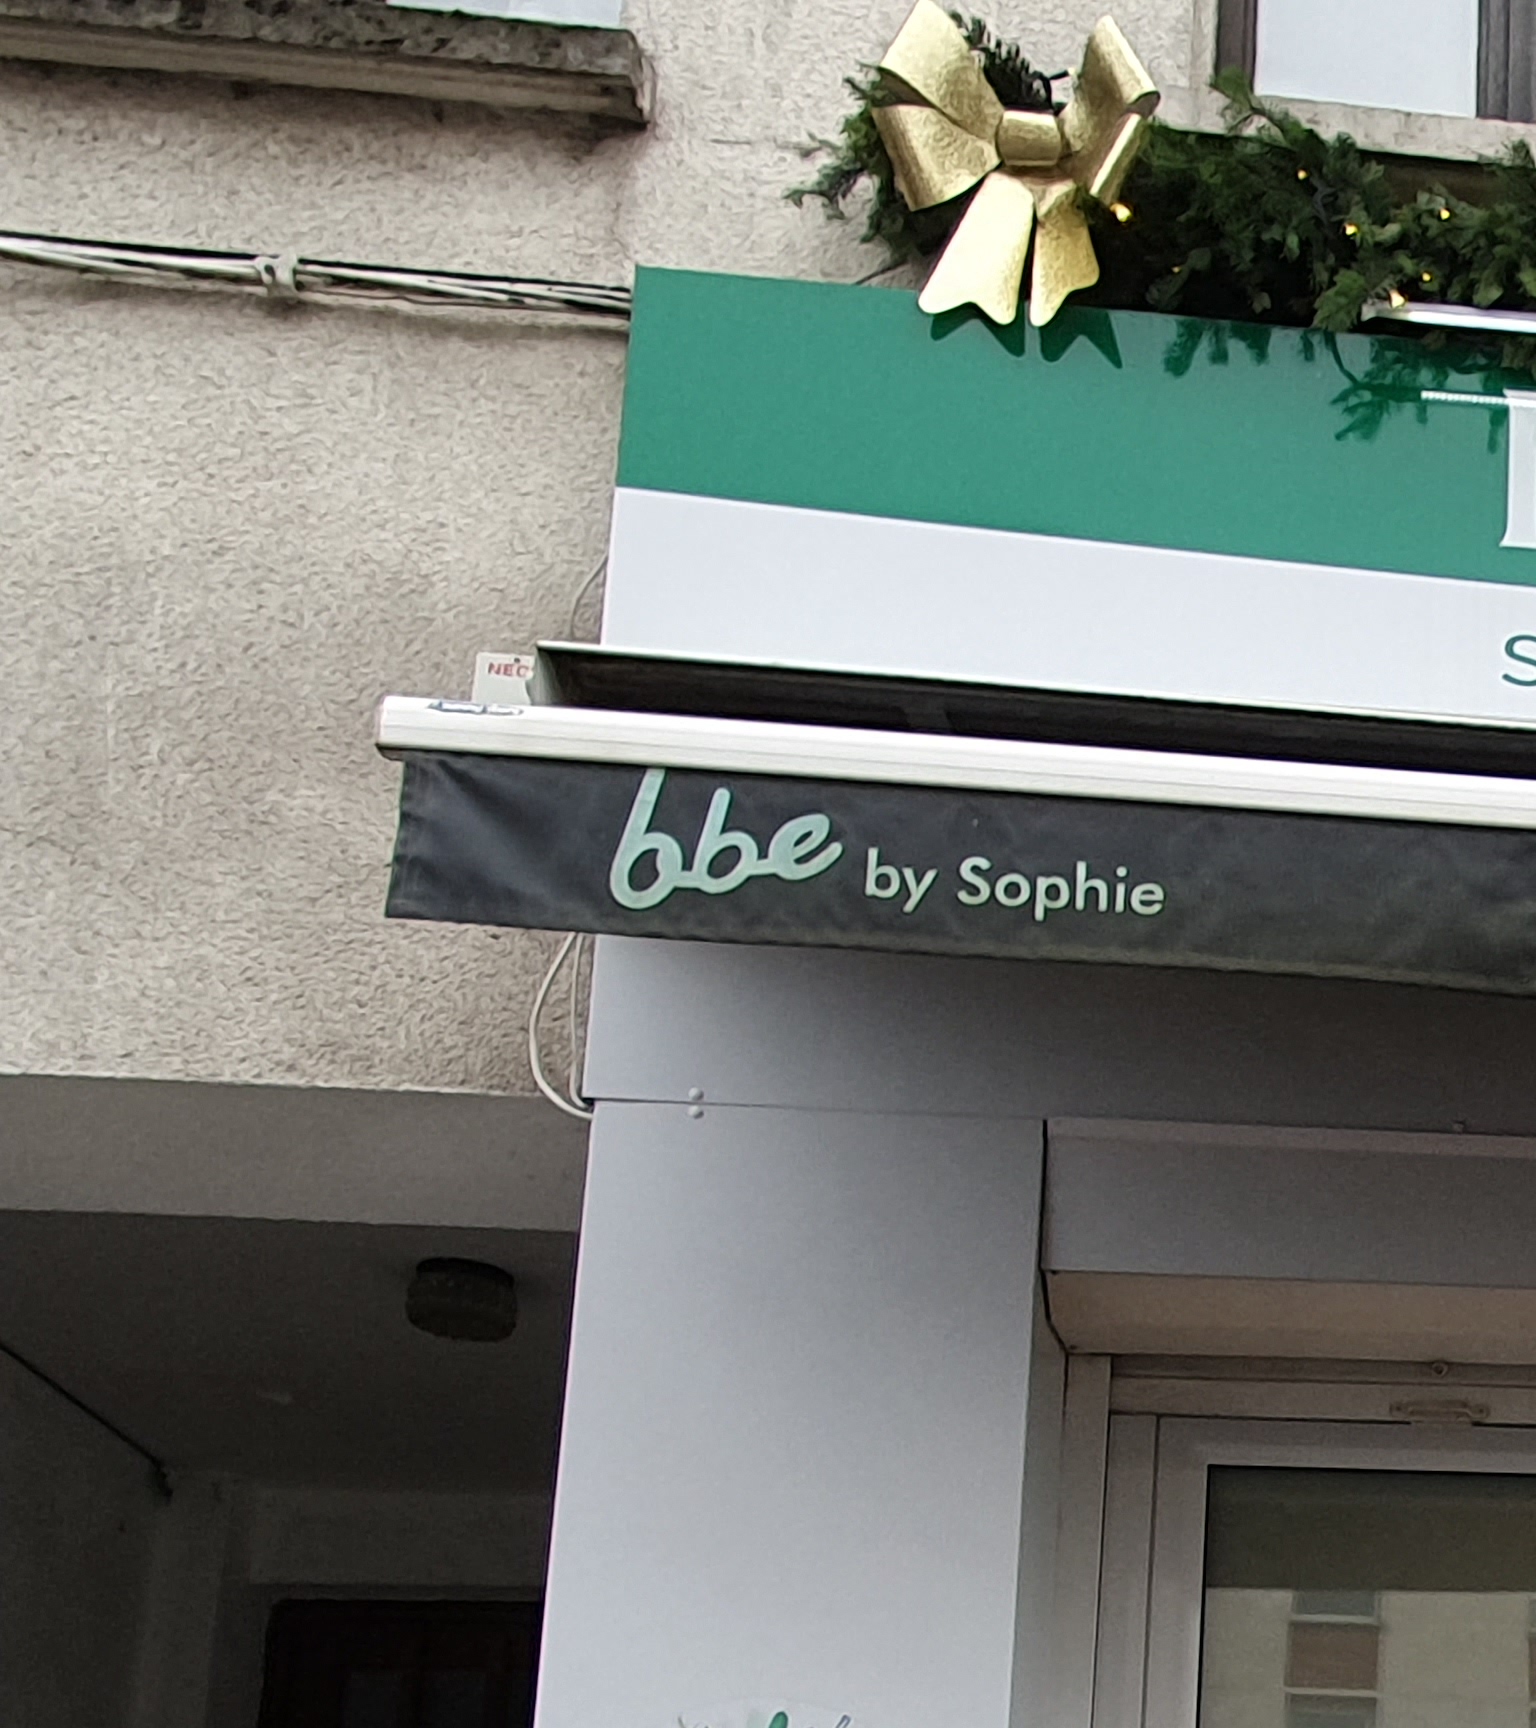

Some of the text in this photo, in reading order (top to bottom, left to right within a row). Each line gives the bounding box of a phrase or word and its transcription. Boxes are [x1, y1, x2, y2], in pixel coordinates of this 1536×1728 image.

[609, 767, 1166, 921] bbe by Sophie
